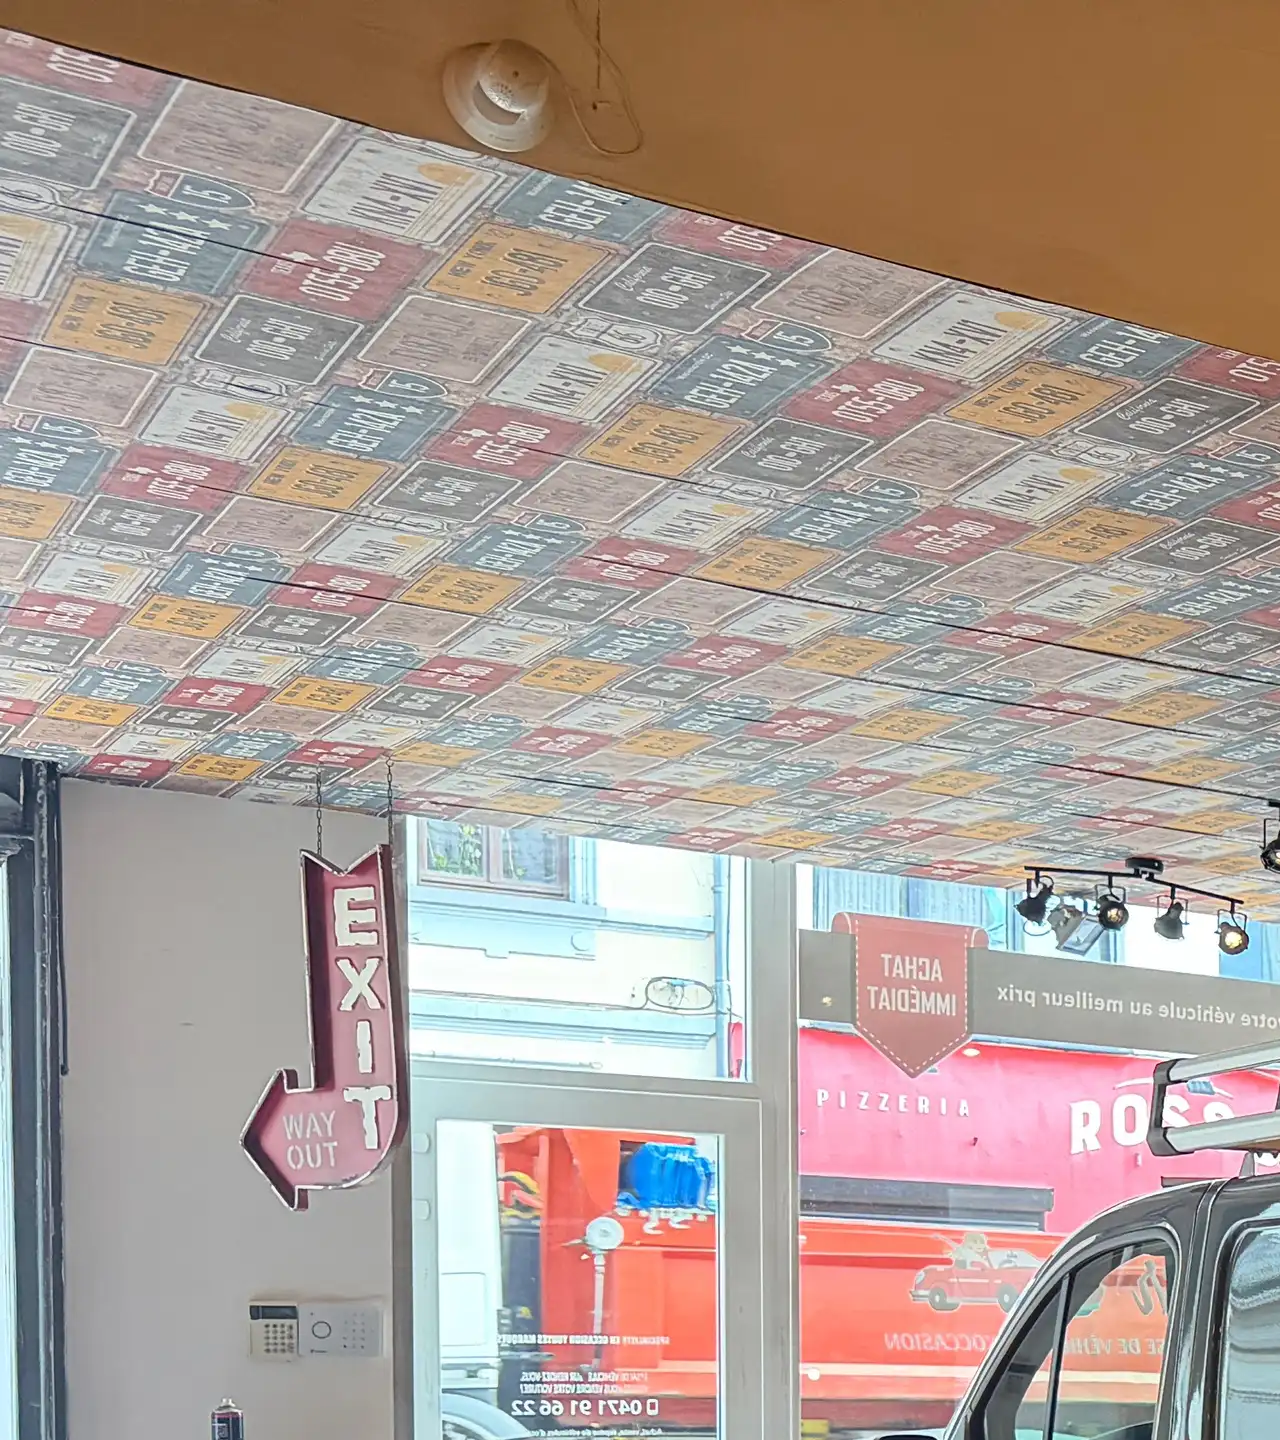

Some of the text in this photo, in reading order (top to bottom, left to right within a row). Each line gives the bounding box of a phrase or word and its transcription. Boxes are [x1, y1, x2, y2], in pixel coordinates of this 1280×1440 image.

[333, 886, 391, 1149] EXIT
[816, 1089, 971, 1117] PIZZERIA
[282, 1110, 337, 1140] WAY
[286, 1141, 338, 1169] OUT
